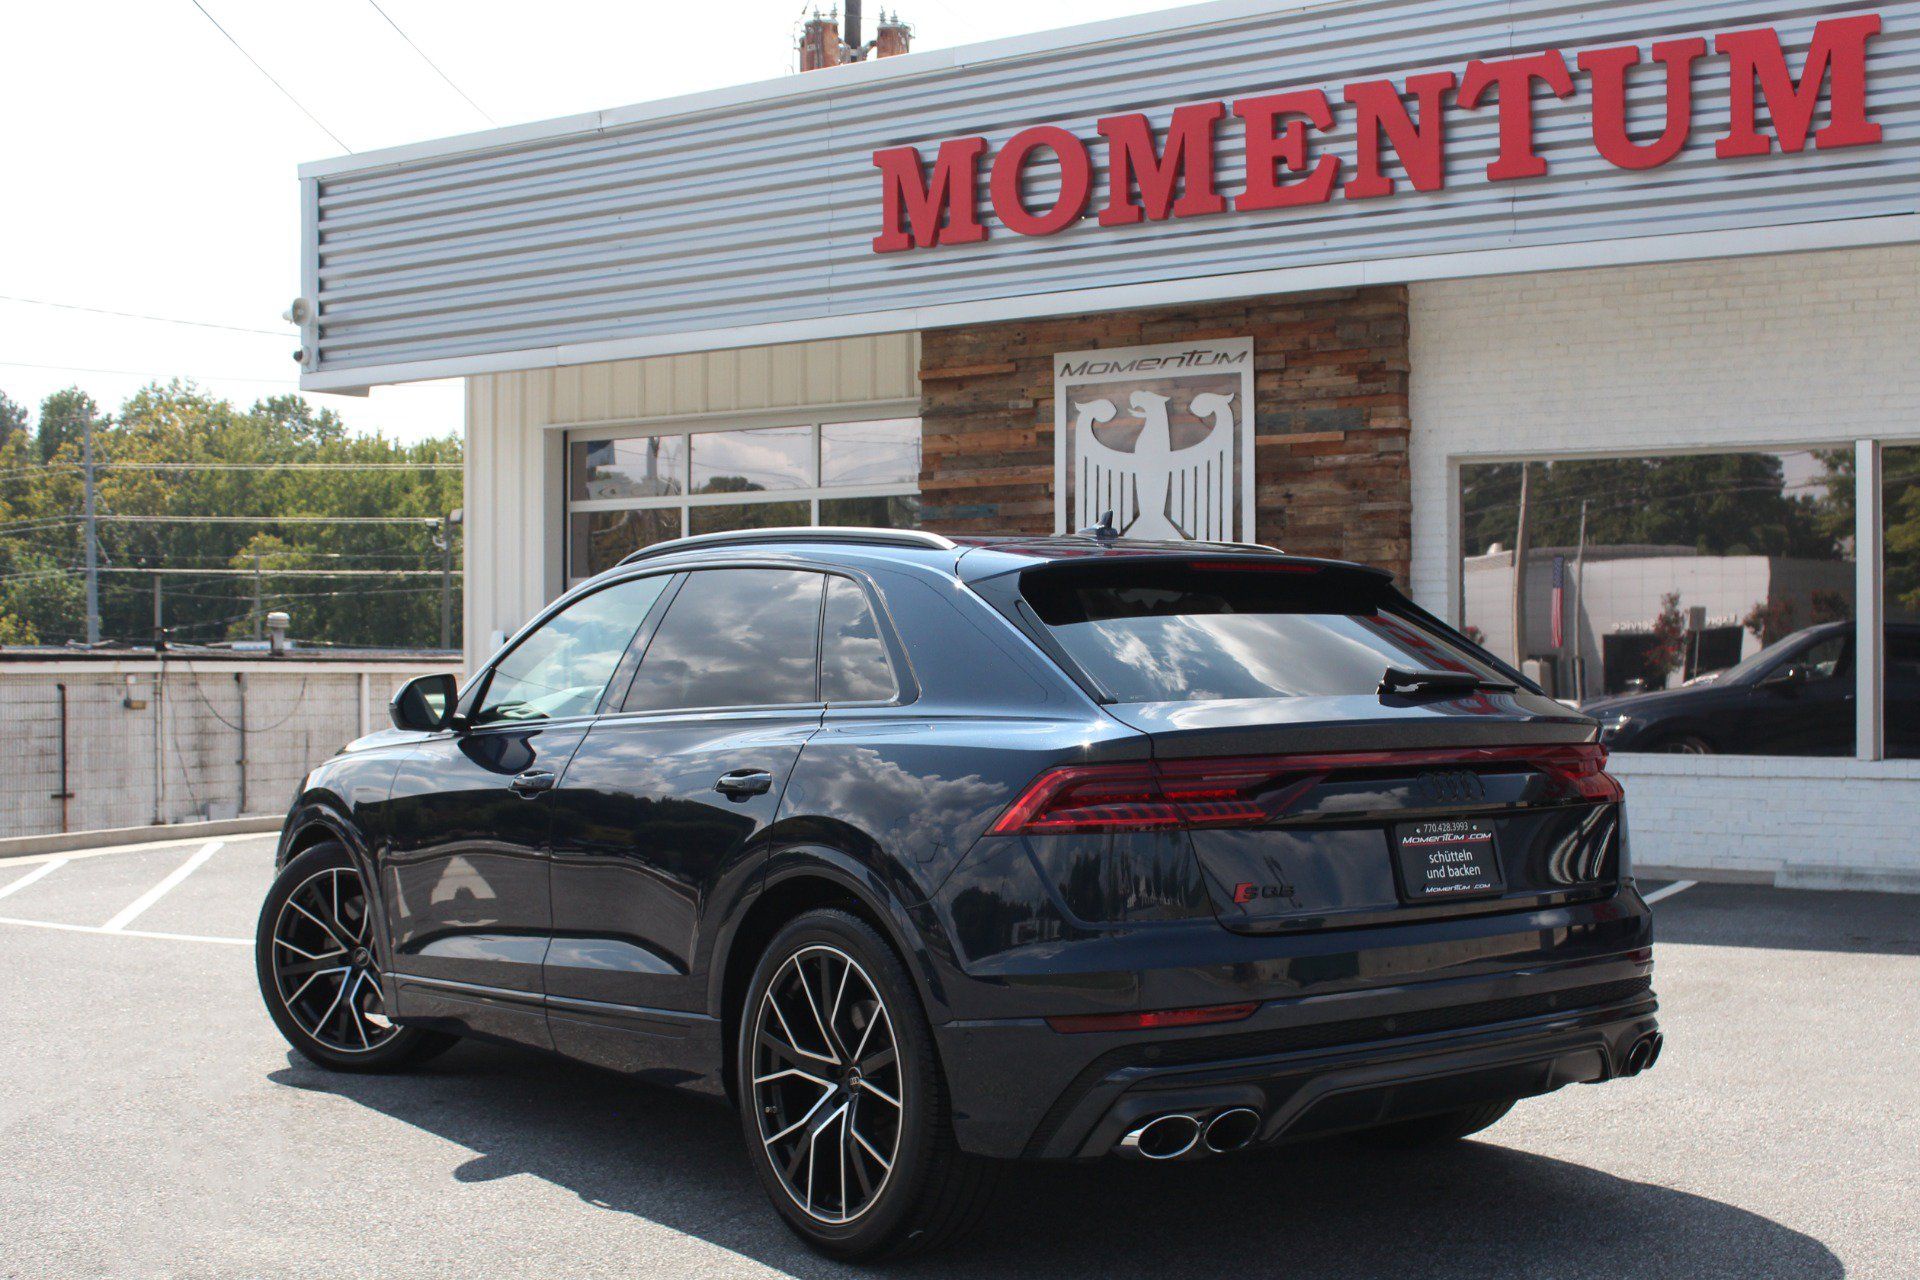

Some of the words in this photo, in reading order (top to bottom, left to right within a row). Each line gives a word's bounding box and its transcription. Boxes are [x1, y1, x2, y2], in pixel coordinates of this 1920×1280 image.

[873, 14, 1882, 253] MOMENTUM
[1424, 822, 1468, 833] 770.428.3993
[1429, 849, 1473, 863] schütteln
[1427, 866, 1445, 878] und
[1448, 865, 1480, 877] backen
